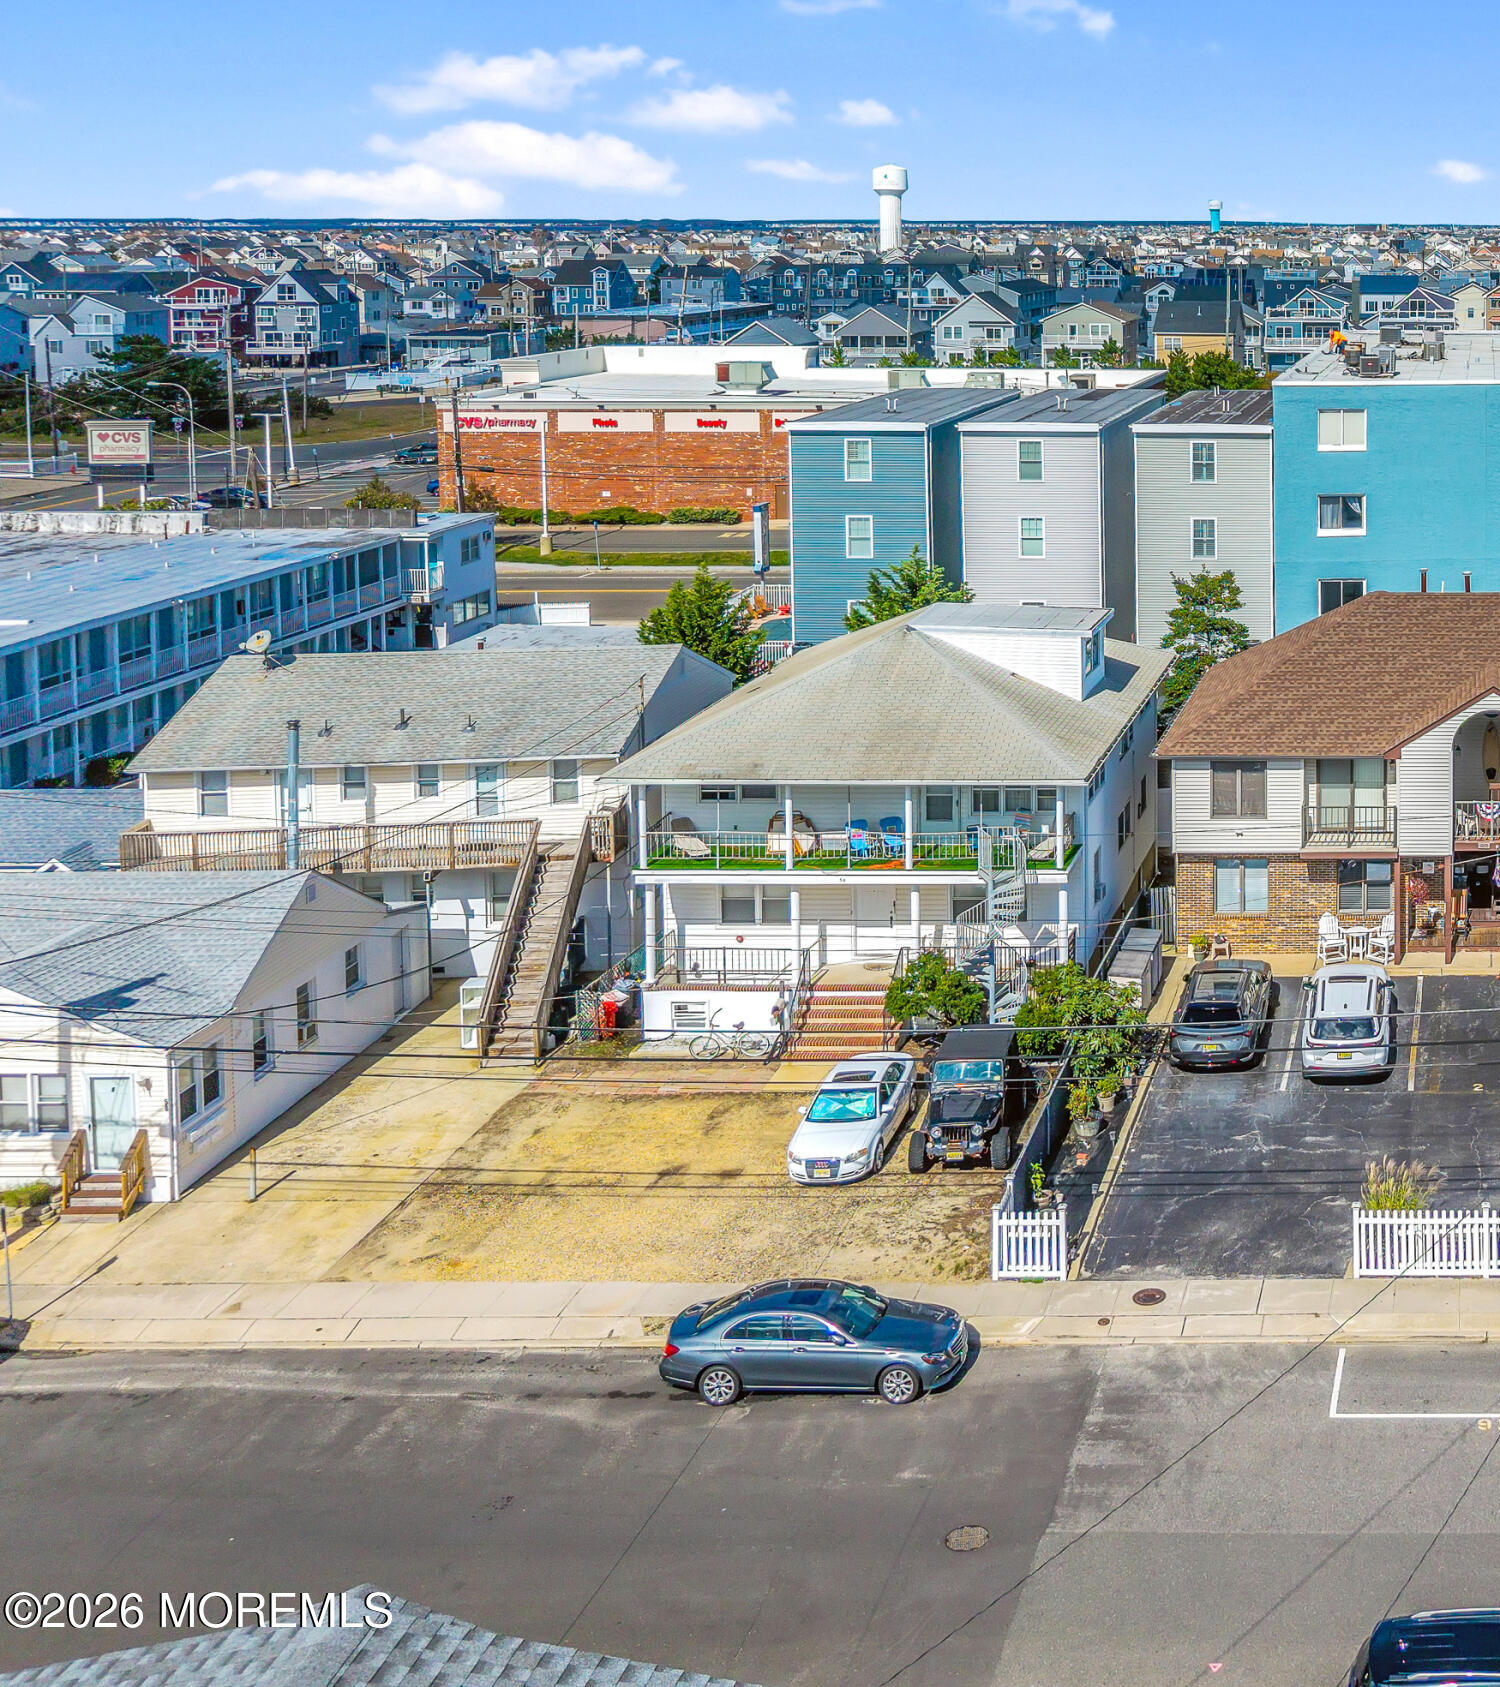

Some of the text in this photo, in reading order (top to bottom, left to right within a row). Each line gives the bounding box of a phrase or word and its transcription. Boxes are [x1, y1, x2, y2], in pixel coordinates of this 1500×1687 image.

[696, 418, 728, 430] Beauty
[111, 431, 142, 444] CVS
[99, 444, 141, 454] pharmacy
